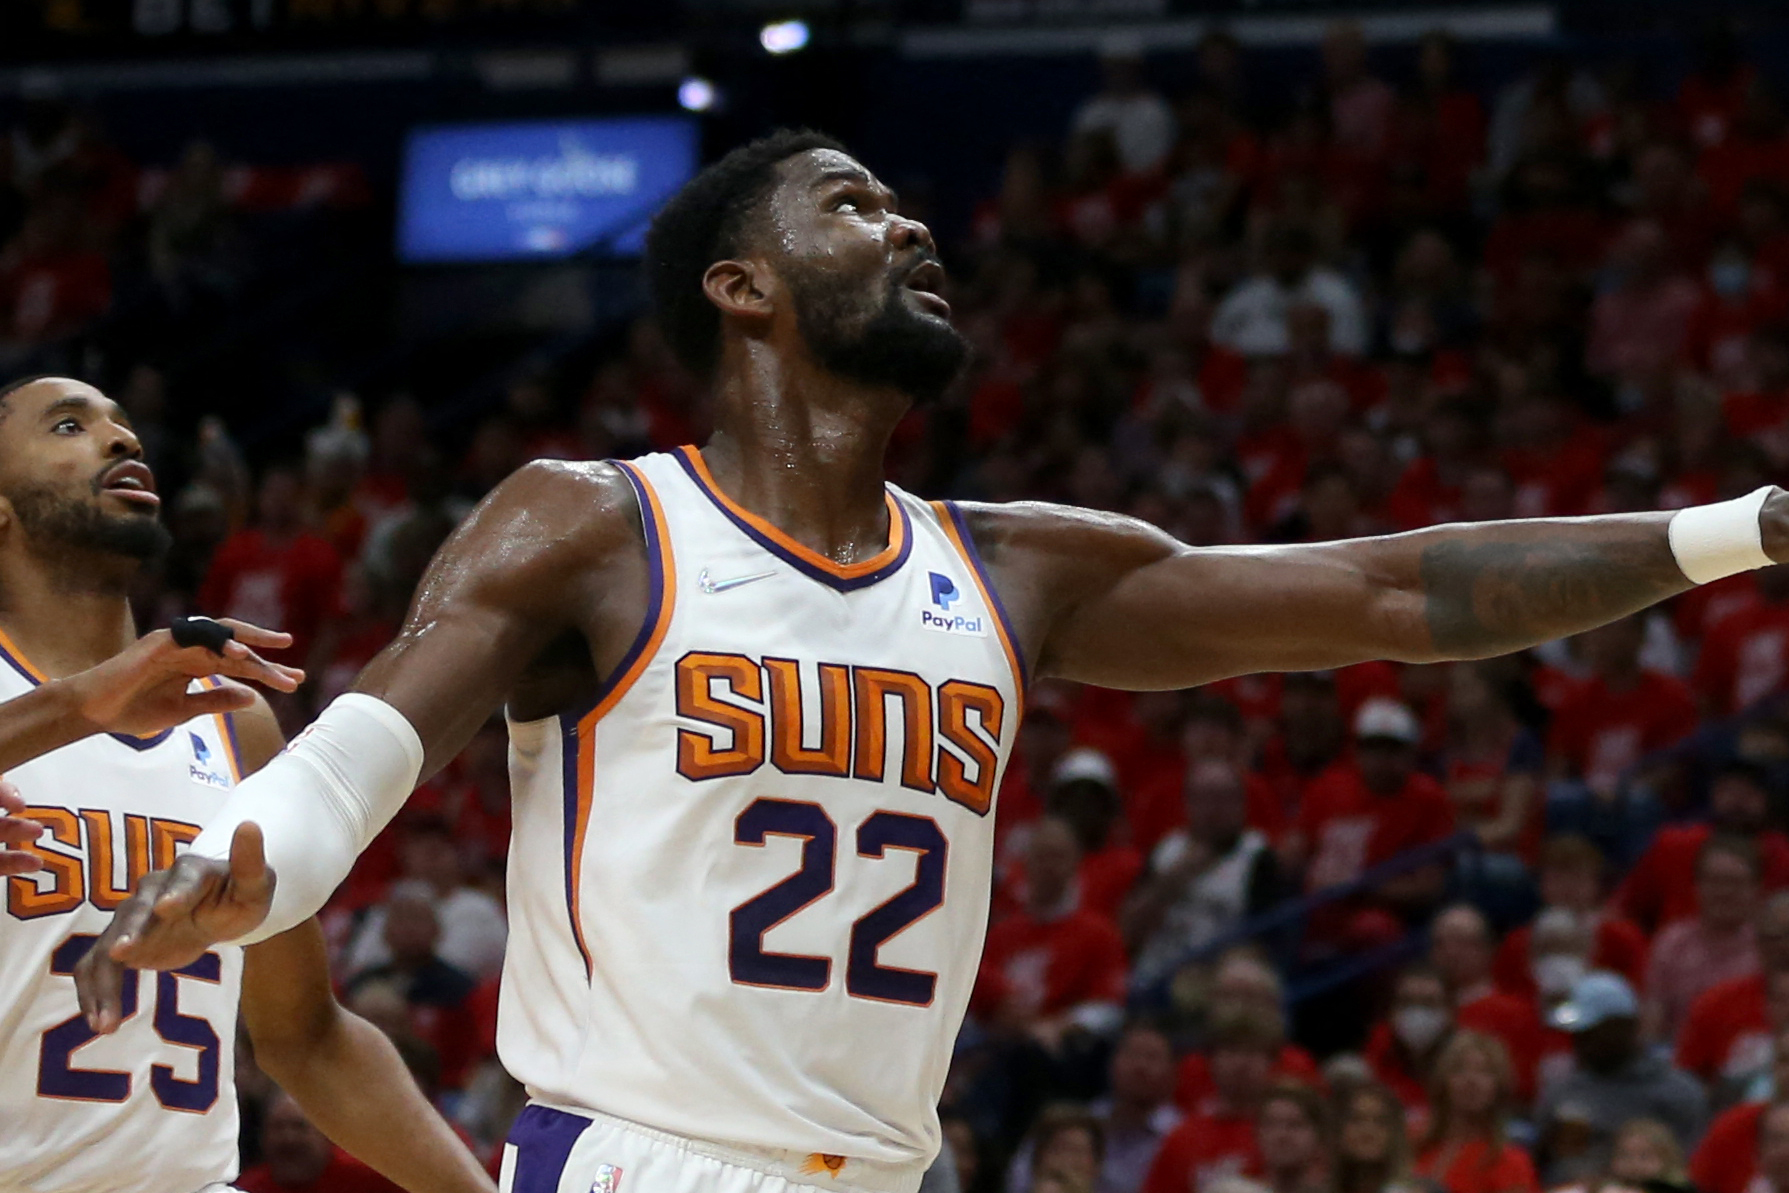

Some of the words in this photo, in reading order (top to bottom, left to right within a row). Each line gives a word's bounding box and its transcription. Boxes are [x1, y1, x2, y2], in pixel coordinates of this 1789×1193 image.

[922, 610, 981, 631] PayPal
[675, 650, 1004, 817] SUNS
[729, 797, 949, 1008] 22
[37, 934, 221, 1115] 25
